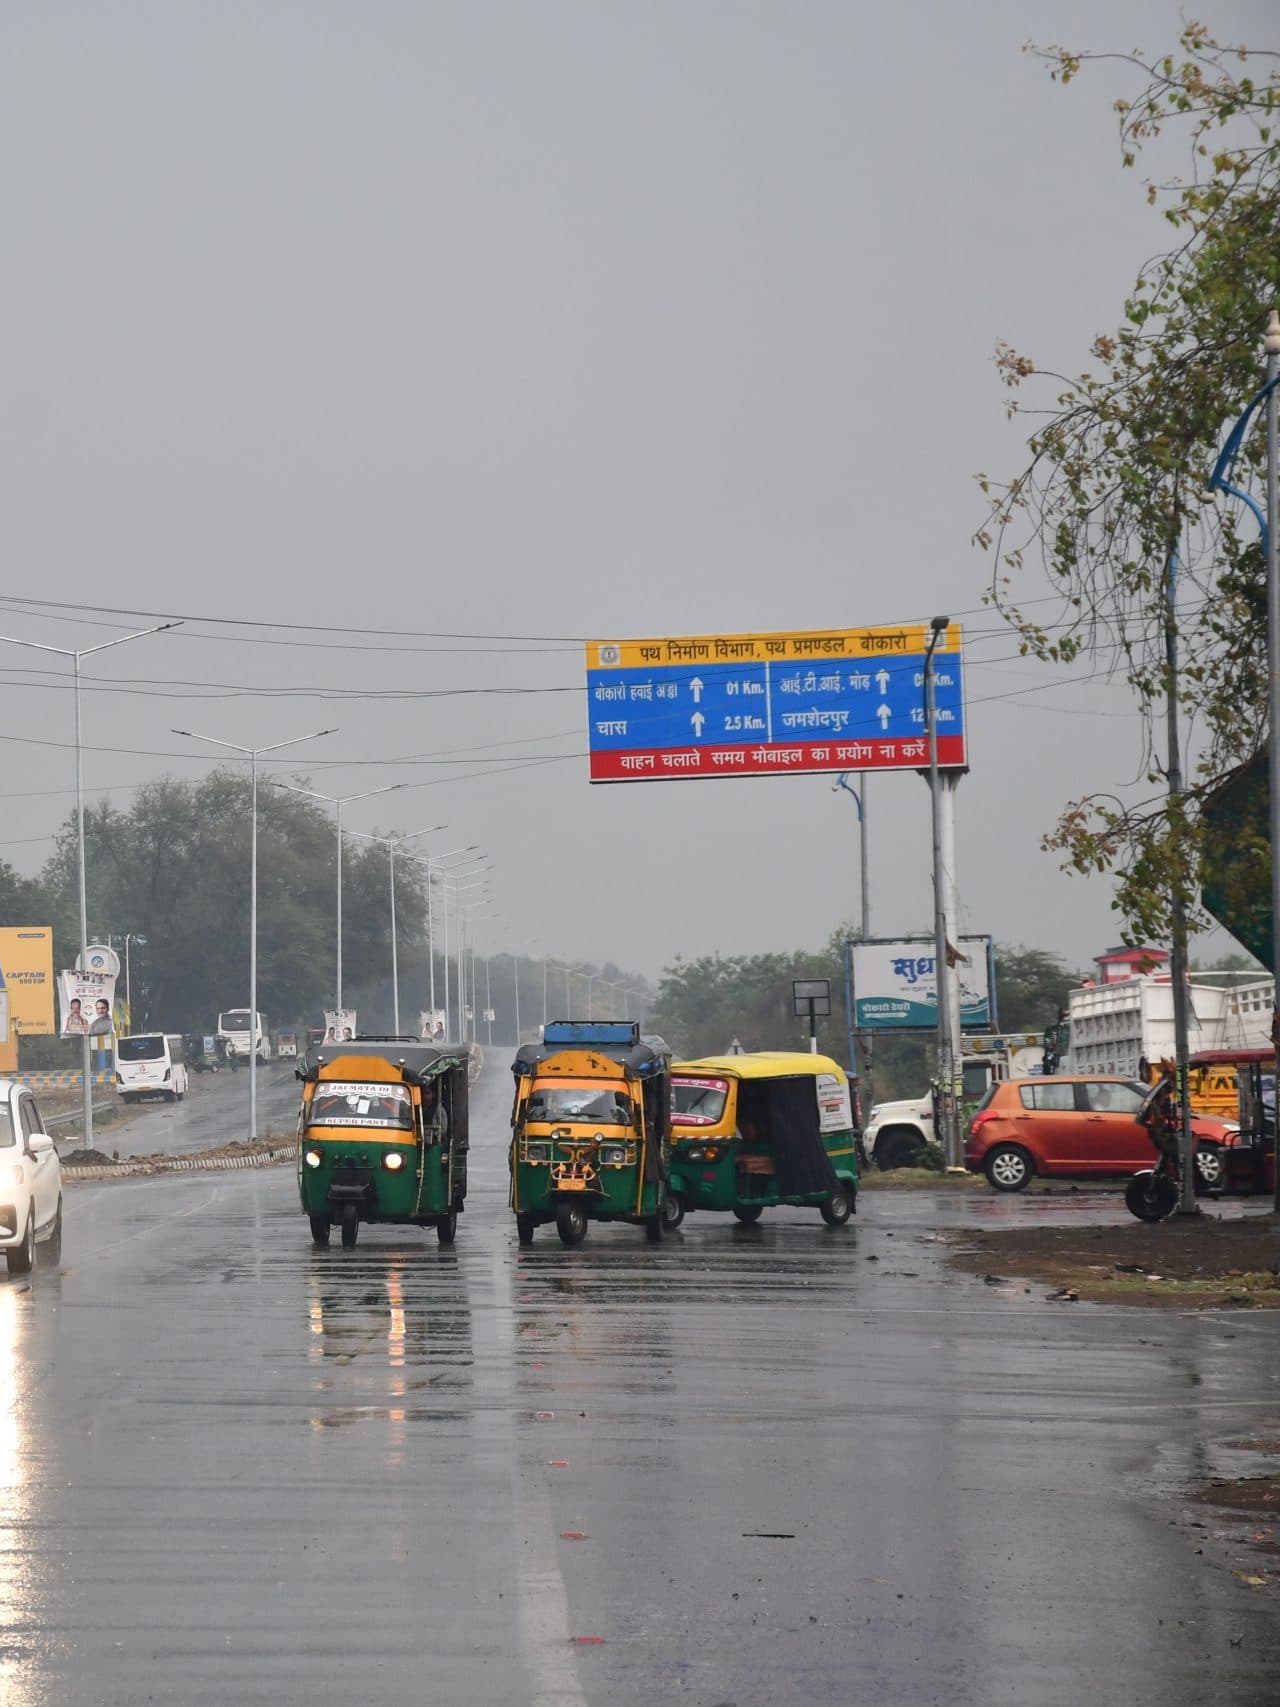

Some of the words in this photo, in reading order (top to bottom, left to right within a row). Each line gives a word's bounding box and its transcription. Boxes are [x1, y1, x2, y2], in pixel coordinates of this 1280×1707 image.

[640, 646, 660, 661] पथ
[667, 640, 709, 660] निर्माण
[714, 638, 761, 658] विभाग,
[765, 641, 785, 655] पथ
[860, 632, 907, 650] बोकारो
[595, 682, 626, 701] बोकारो
[630, 680, 652, 701] हवाई
[727, 681, 739, 695] 01
[743, 681, 765, 695] Km.
[725, 715, 741, 730] 2.5
[744, 715, 766, 729] Km.
[782, 707, 849, 732] जमशेदपुर
[911, 708, 929, 722] 12
[596, 721, 627, 736] चास
[621, 755, 655, 770] वाहन
[661, 748, 701, 768] चलाते
[711, 751, 745, 766] समय
[751, 746, 803, 765] मोबाइल
[811, 748, 830, 760] का
[837, 742, 872, 760] प्रयोग
[879, 745, 896, 759] ना
[902, 740, 925, 757] करें
